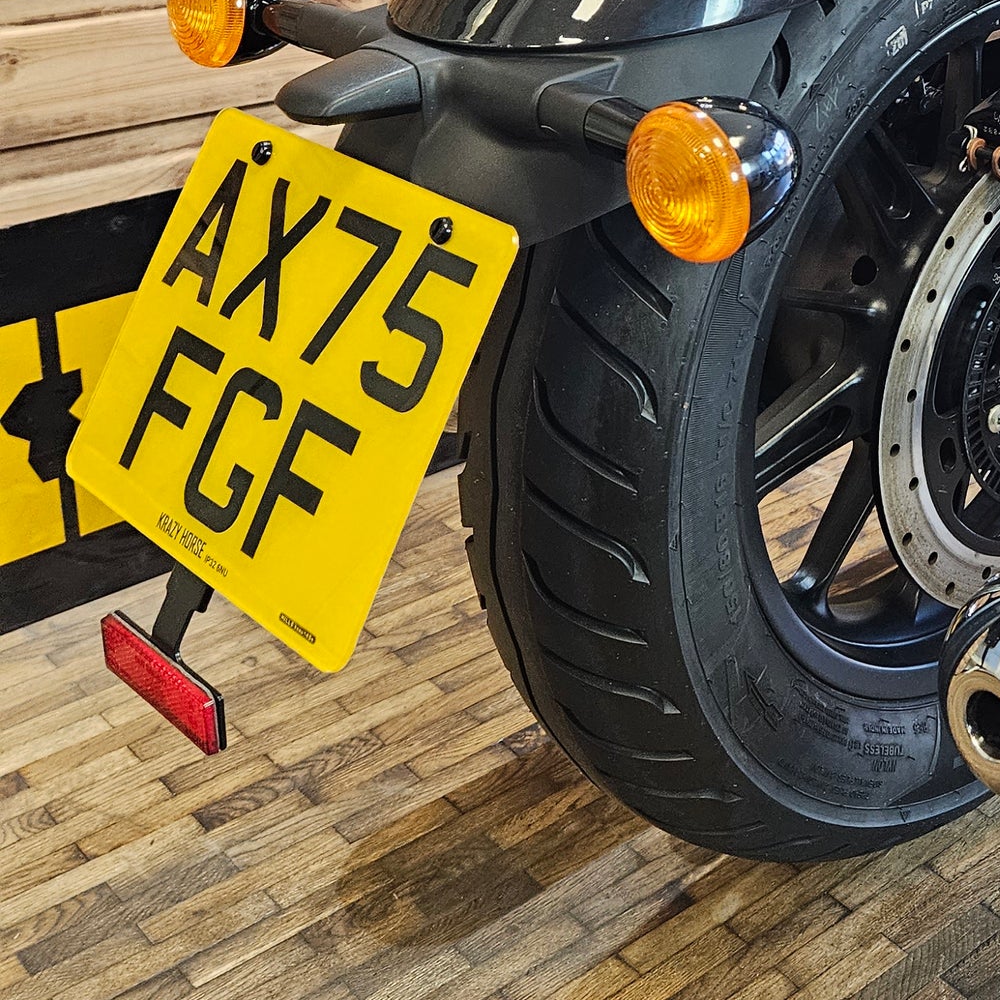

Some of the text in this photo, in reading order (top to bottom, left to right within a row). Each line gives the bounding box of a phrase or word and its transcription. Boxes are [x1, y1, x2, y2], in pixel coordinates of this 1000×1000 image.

[162, 158, 479, 413] AX75
[119, 325, 362, 559] FGF
[156, 512, 183, 541] KRAZY
[178, 527, 208, 559] HORSE
[863, 742, 904, 757] TUBELESS
